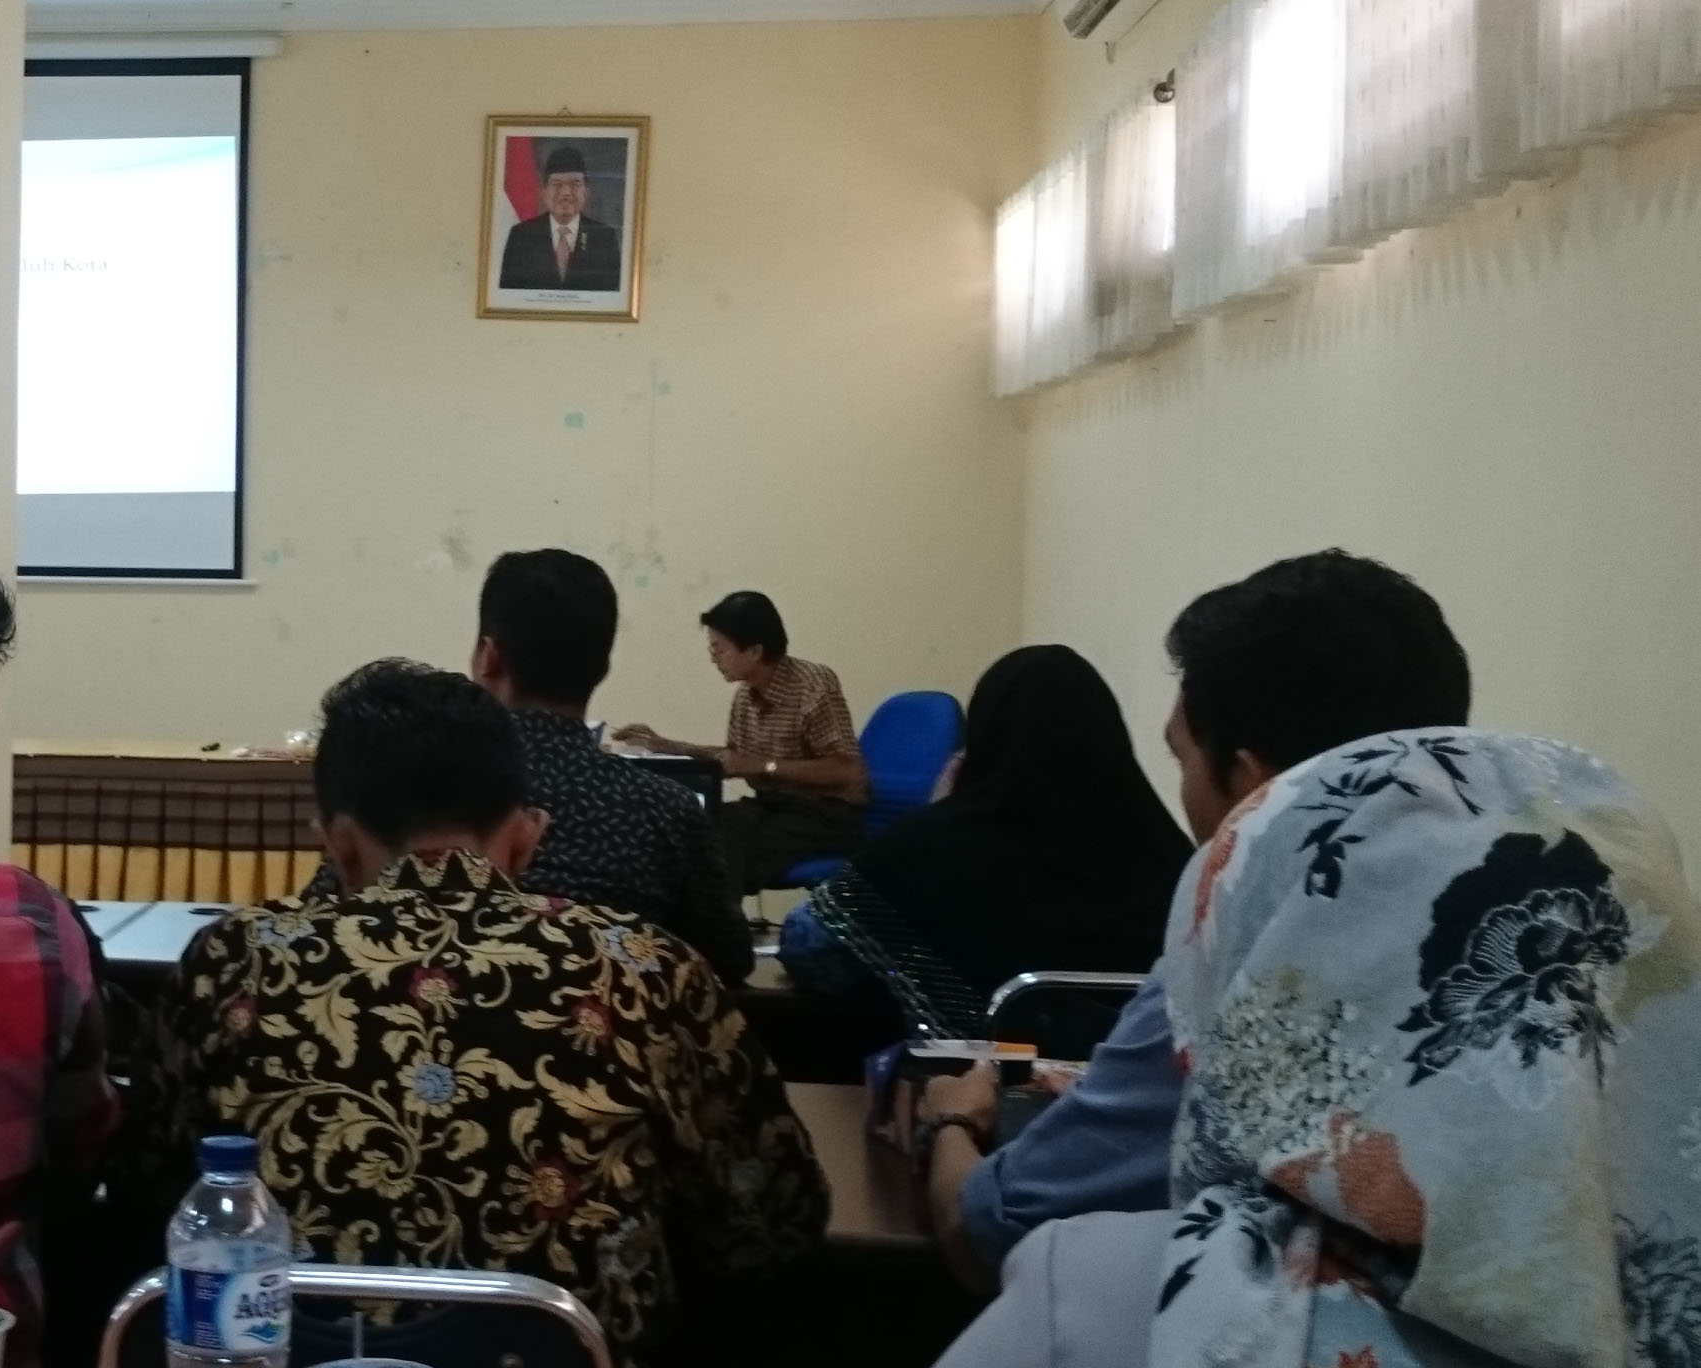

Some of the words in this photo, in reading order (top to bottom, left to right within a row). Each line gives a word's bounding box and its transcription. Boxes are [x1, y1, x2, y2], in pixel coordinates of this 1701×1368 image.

[19, 256, 54, 273] luh
[63, 256, 108, 273] Kota
[233, 1289, 290, 1319] AQU
